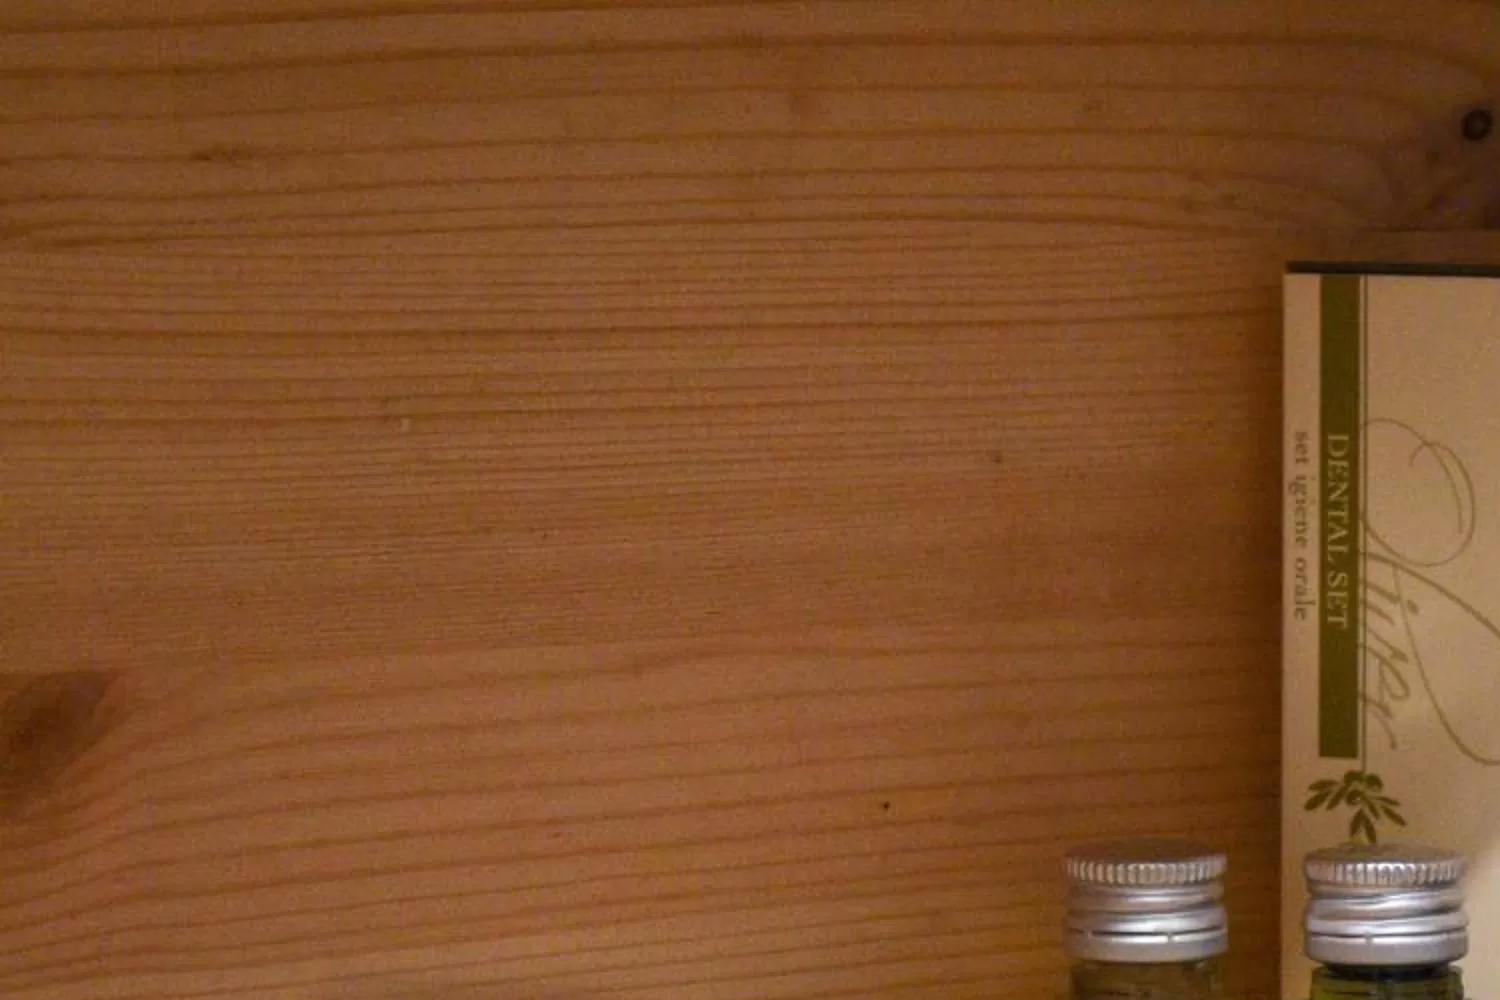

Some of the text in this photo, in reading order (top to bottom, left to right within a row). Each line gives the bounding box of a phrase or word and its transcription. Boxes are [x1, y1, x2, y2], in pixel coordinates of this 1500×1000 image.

[1295, 431, 1311, 465] set
[1326, 434, 1350, 630] DENTAL SET
[1295, 557, 1317, 621] orale
